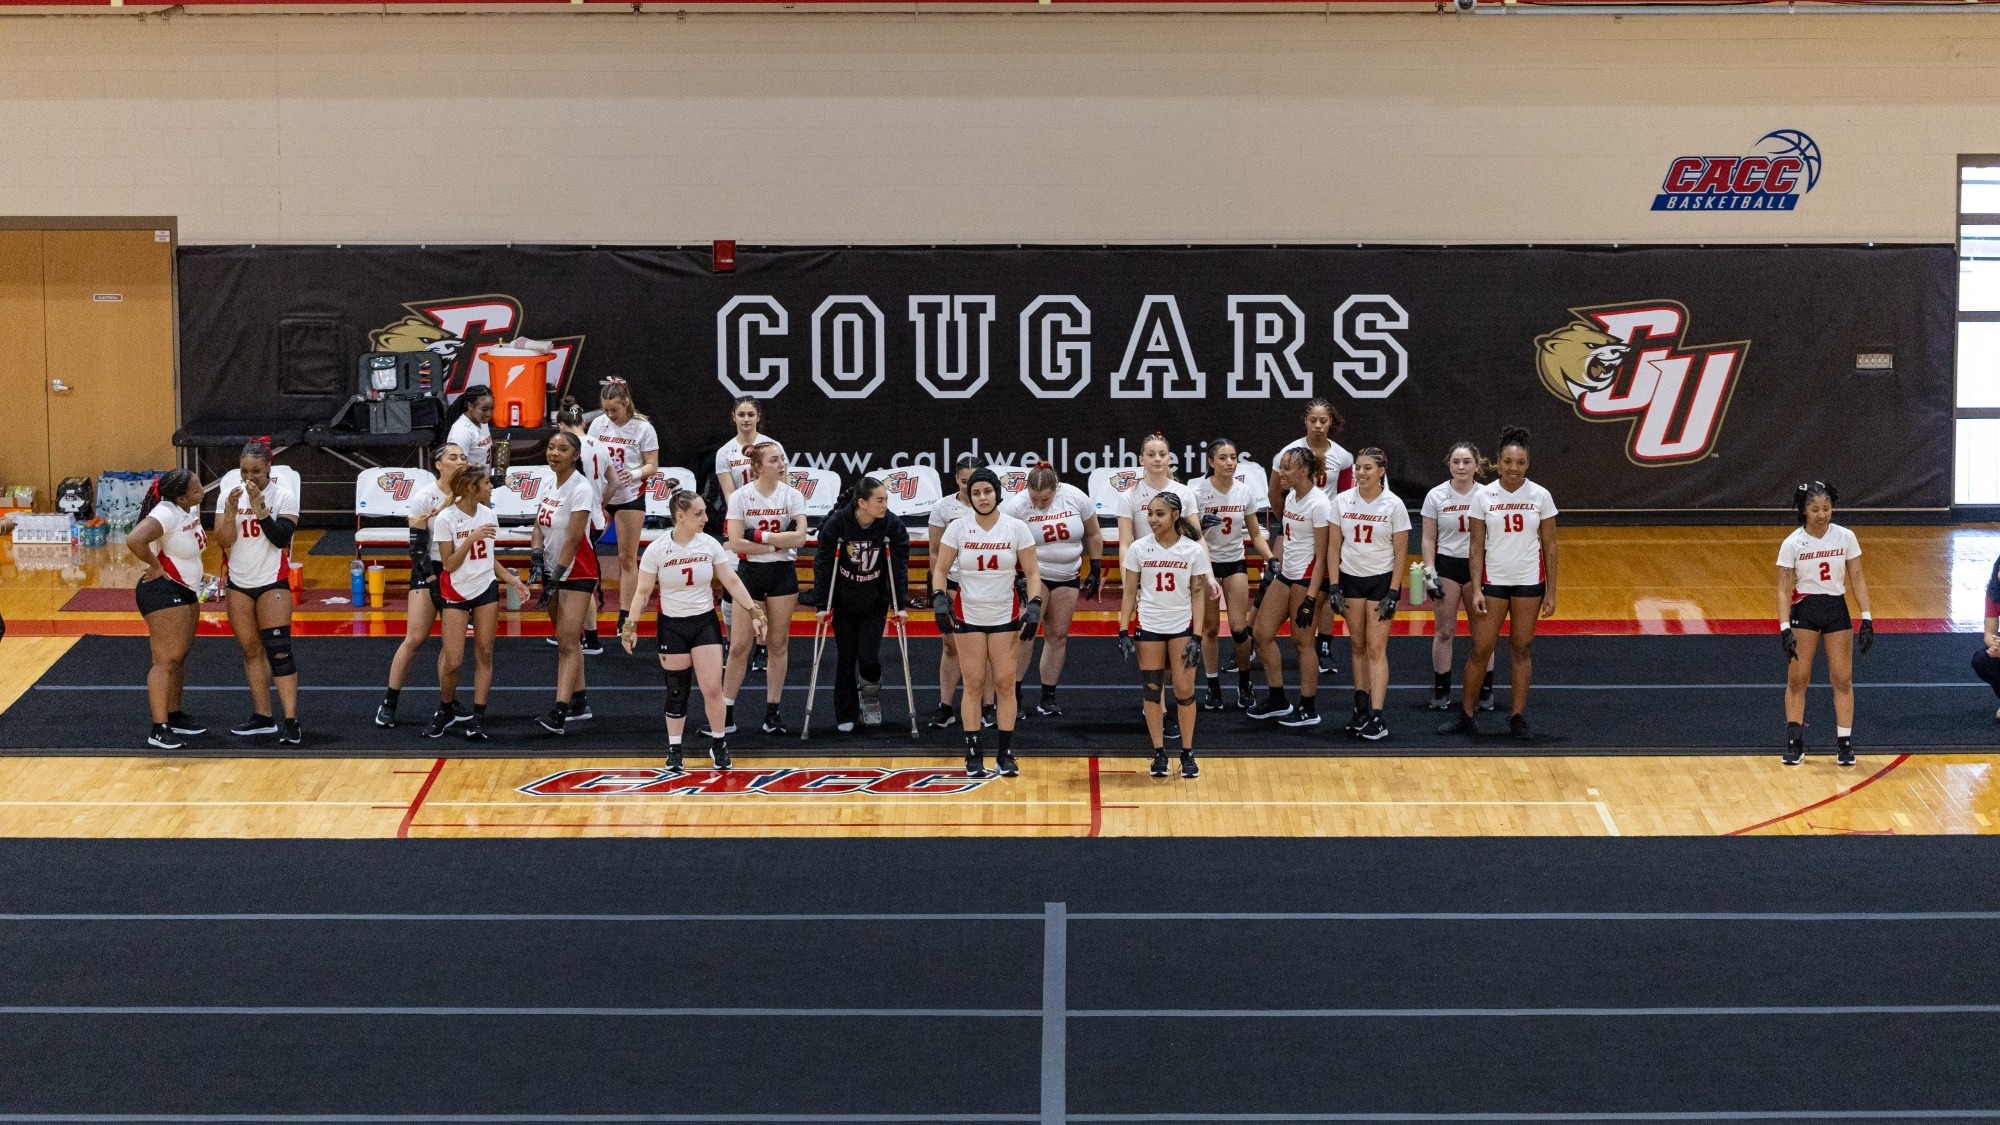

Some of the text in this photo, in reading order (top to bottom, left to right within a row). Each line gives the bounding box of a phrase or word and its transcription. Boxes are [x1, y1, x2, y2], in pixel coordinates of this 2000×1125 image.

[1662, 156, 1803, 194] CACC
[1666, 196, 1786, 209] BASKETBALL
[717, 294, 1410, 399] COUGARS
[1489, 503, 1535, 511] CALDWELL
[539, 507, 555, 528] 25
[1028, 511, 1073, 523] CALDWELL
[1221, 516, 1233, 535] 3
[1342, 511, 1388, 523] CALDWELL
[1503, 513, 1524, 532] 19
[241, 518, 261, 538] 16
[1042, 522, 1071, 543] 26
[1353, 524, 1374, 544] 17
[470, 539, 488, 560] 12
[964, 541, 1012, 550] CALDWELL
[1799, 548, 1845, 560] CALDWELL
[976, 554, 999, 571] 14
[1142, 561, 1188, 569] CALDWELL
[1818, 561, 1831, 581] 2
[681, 567, 694, 586] 7
[1155, 572, 1176, 592] 13
[515, 767, 1000, 797] CACC
